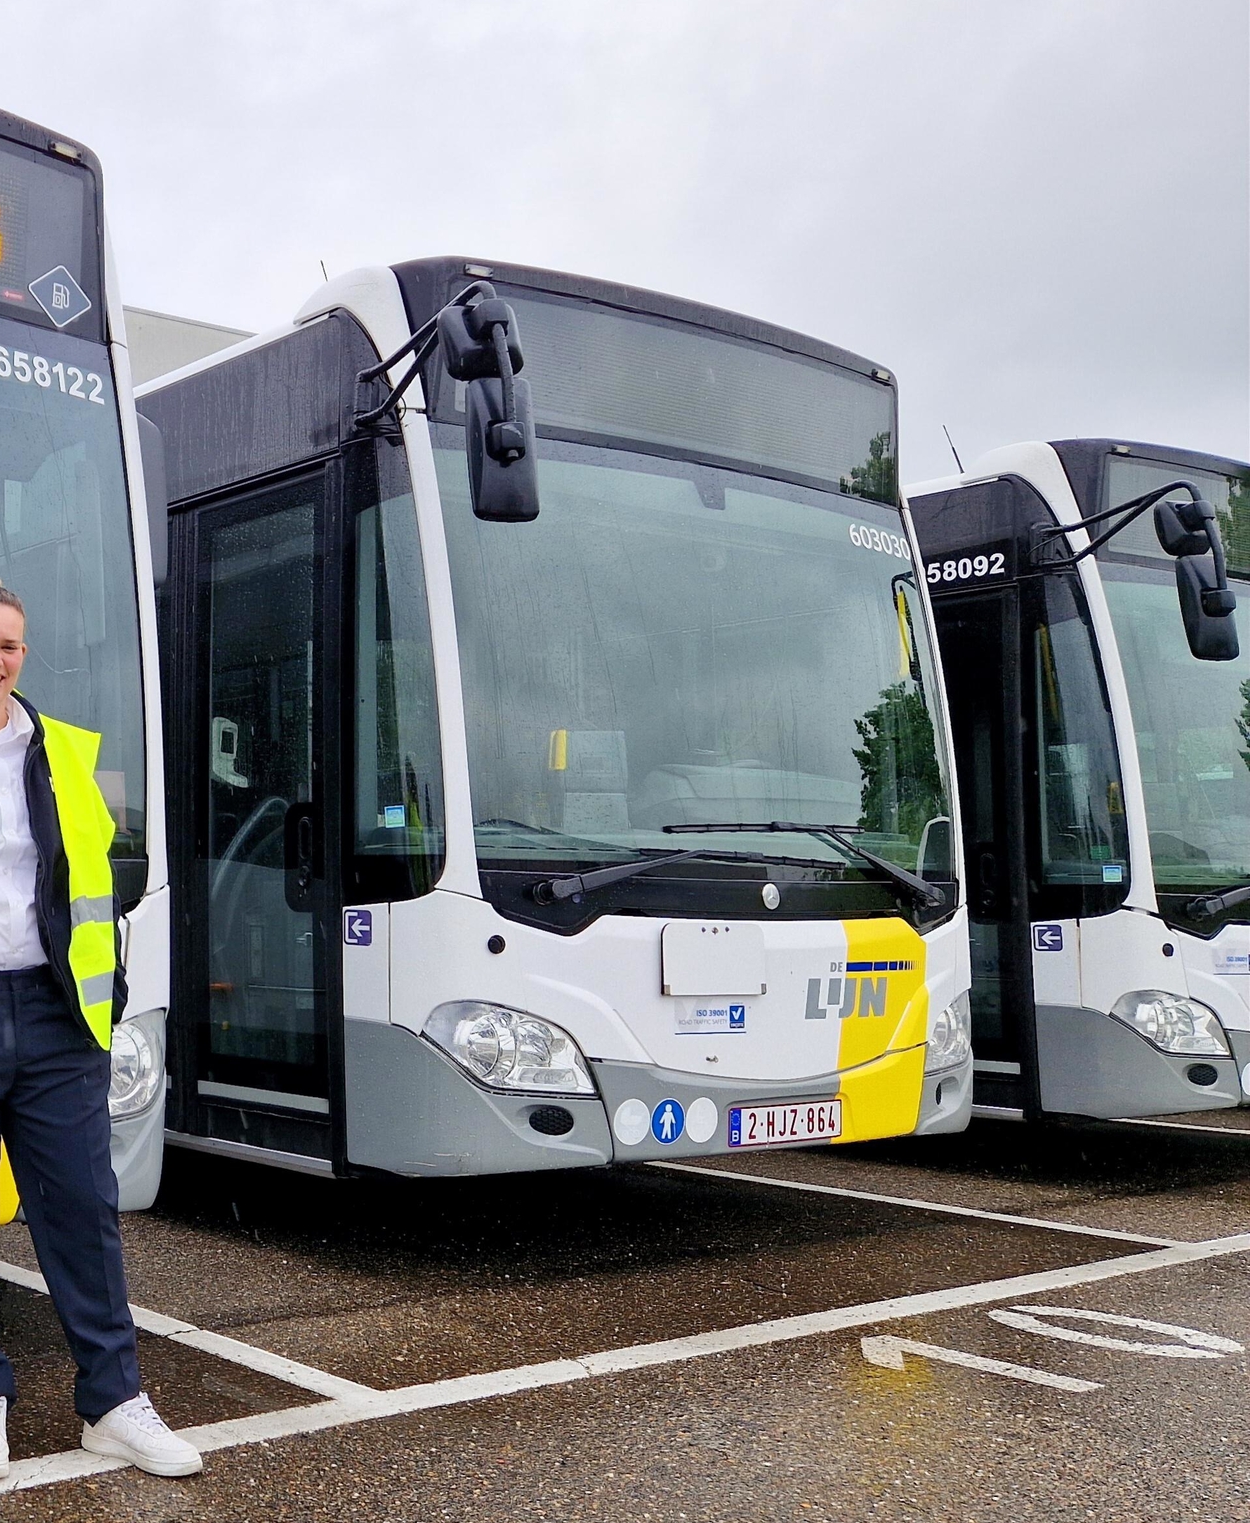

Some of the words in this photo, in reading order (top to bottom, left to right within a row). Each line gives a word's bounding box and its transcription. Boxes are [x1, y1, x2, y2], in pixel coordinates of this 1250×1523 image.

[849, 523, 911, 561] 603030
[923, 553, 1005, 584] 58092
[830, 961, 843, 972] DE
[805, 976, 888, 1019] LIJN
[696, 1009, 708, 1017] ISO
[709, 1009, 728, 1017] 39001
[731, 1130, 740, 1142] B
